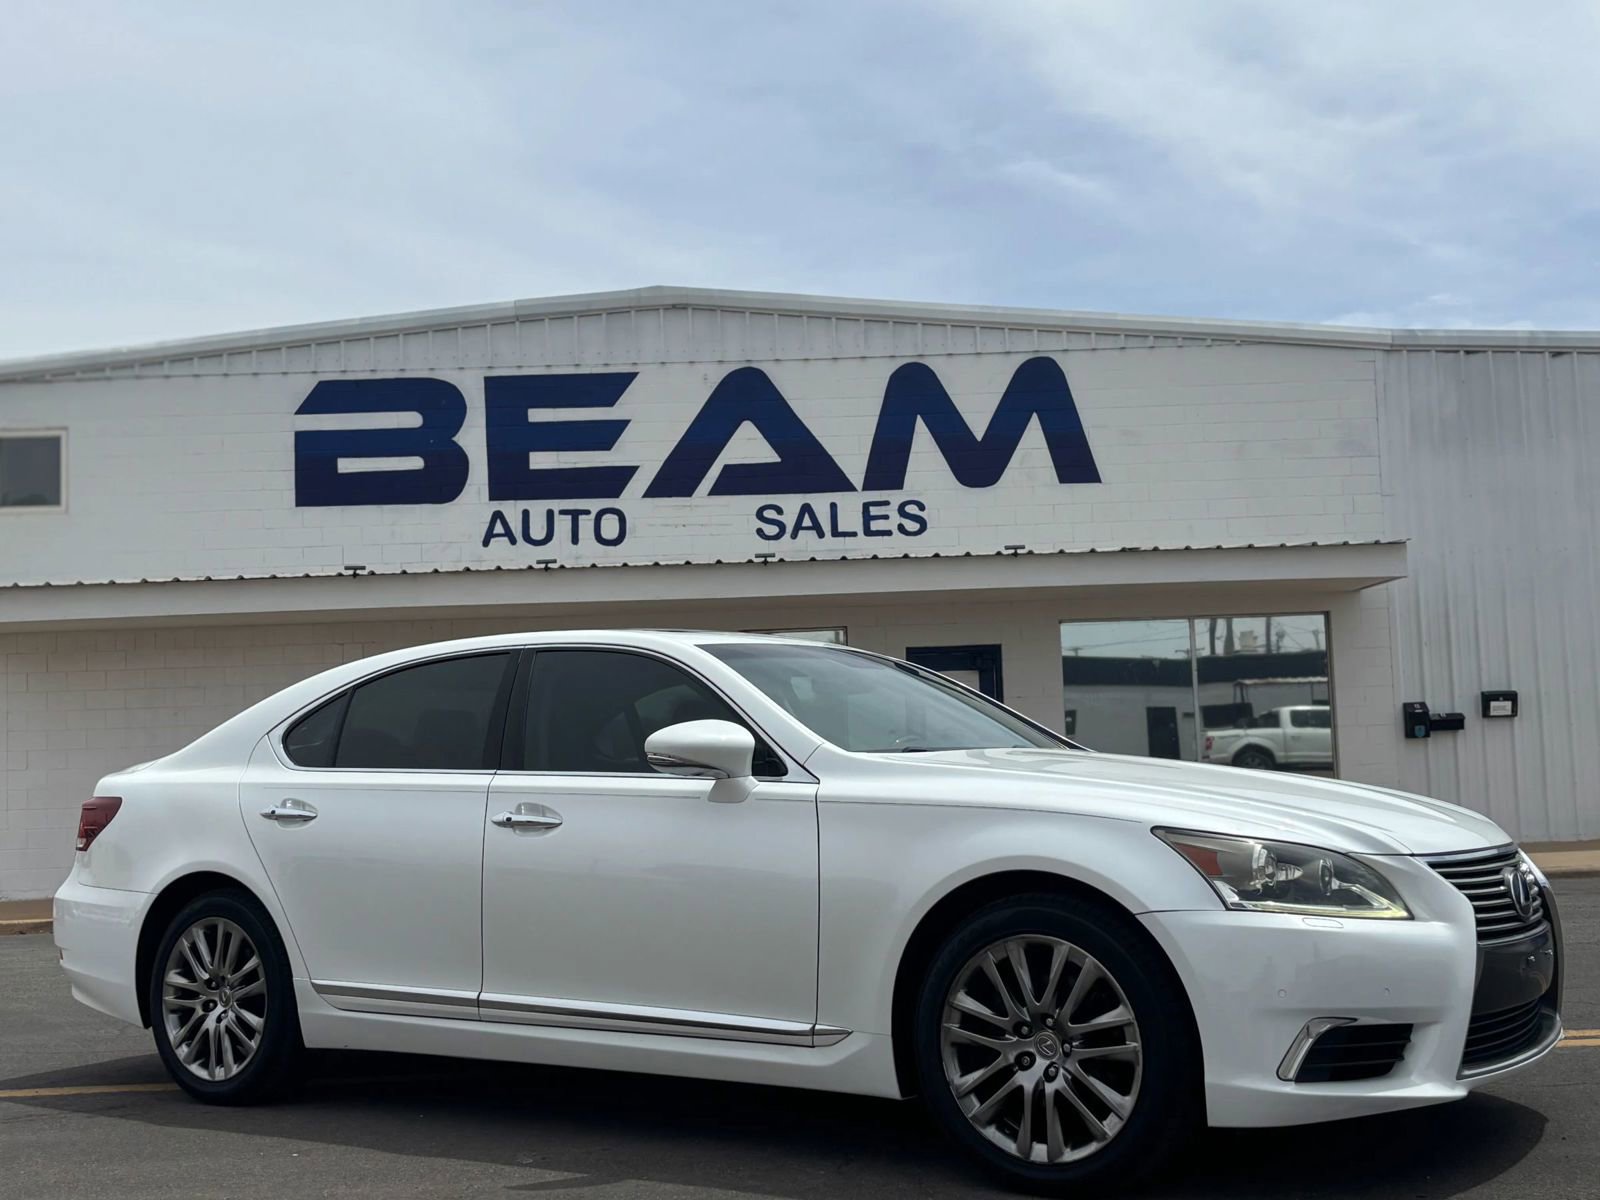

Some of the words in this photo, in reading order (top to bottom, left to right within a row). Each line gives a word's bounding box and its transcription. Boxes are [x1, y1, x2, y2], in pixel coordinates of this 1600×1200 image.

[294, 356, 1102, 507] BEAM
[482, 508, 626, 547] AUTO
[756, 500, 928, 540] SALES
